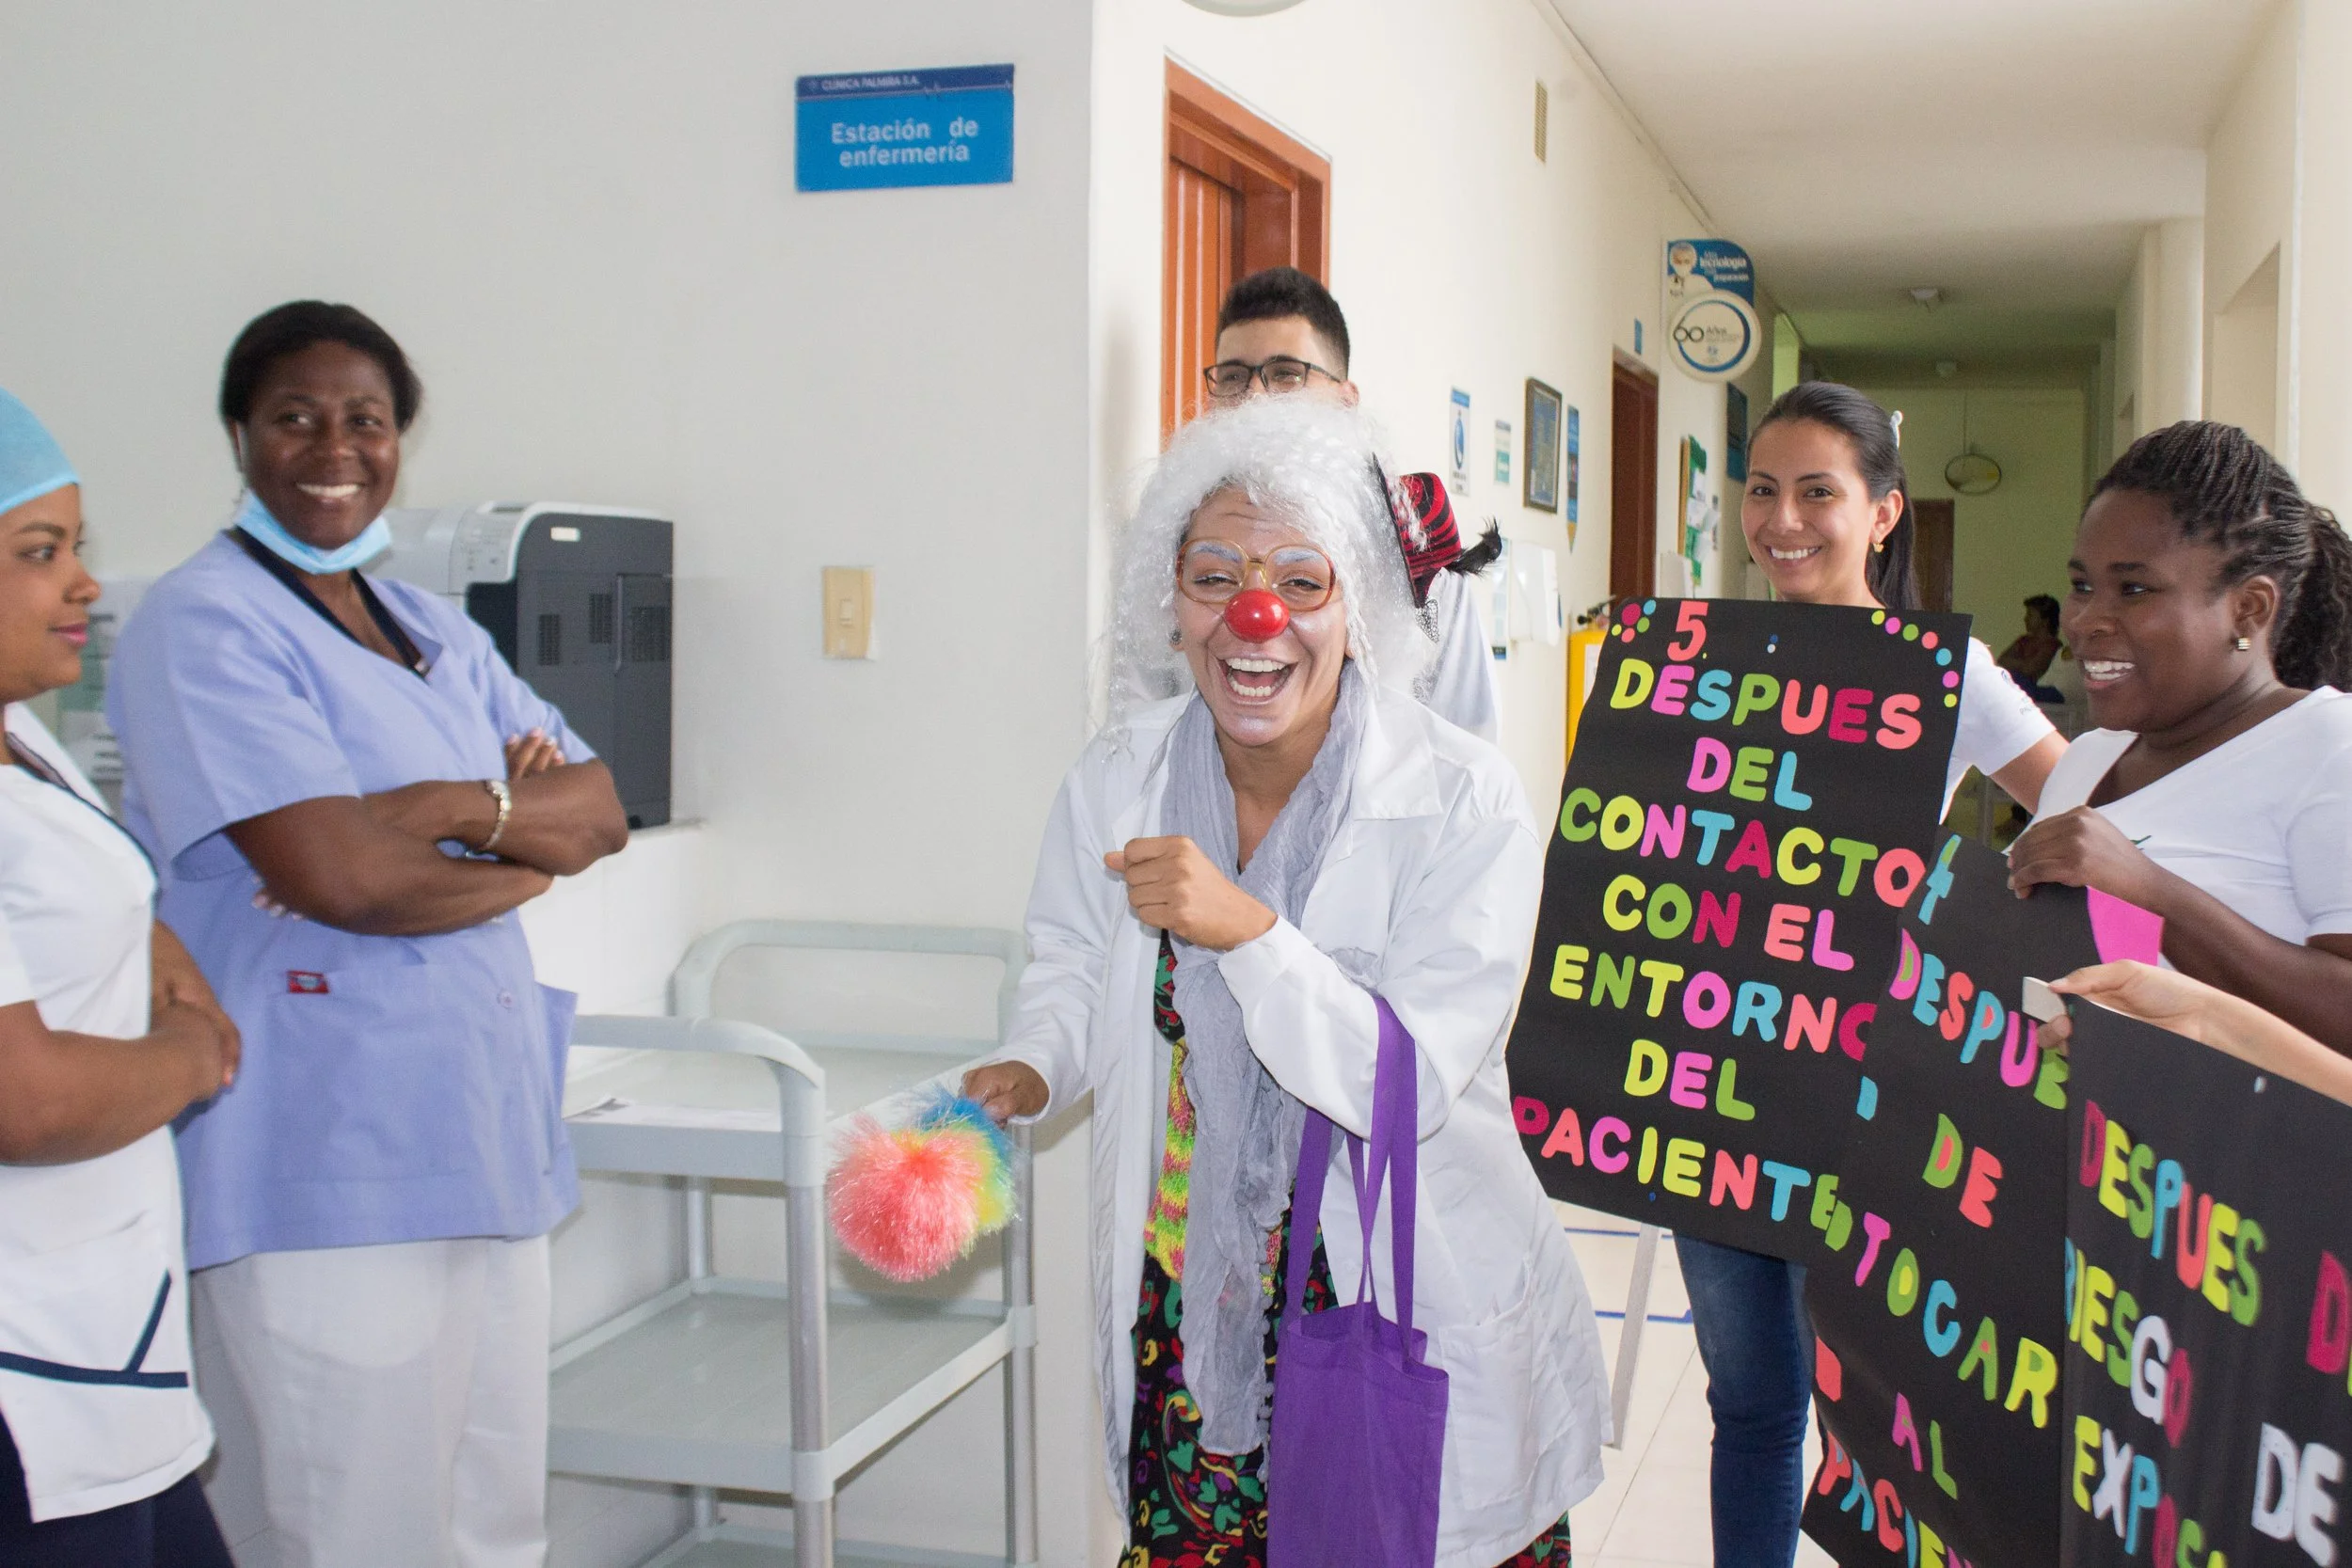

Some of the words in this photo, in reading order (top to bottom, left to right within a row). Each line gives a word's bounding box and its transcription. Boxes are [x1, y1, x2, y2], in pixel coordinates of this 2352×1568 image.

[831, 118, 931, 145] Estación
[948, 116, 980, 139] de
[838, 140, 970, 167] enfermería
[1610, 657, 1923, 751] DESPUES
[1687, 736, 1813, 812] DEL
[1560, 787, 1927, 909] CONTACTO
[1602, 874, 1742, 949] CON
[1764, 903, 1855, 972] EL
[1889, 927, 2069, 1111] DESPUE
[1624, 1038, 1756, 1121] DEL
[1922, 1113, 2005, 1228] DE
[2079, 1099, 2266, 1328] DESPUES
[2306, 1249, 2352, 1399] D
[1854, 1210, 2059, 1430] TOCAR
[1892, 1391, 1961, 1501] AL
[2250, 1421, 2344, 1568] DE
